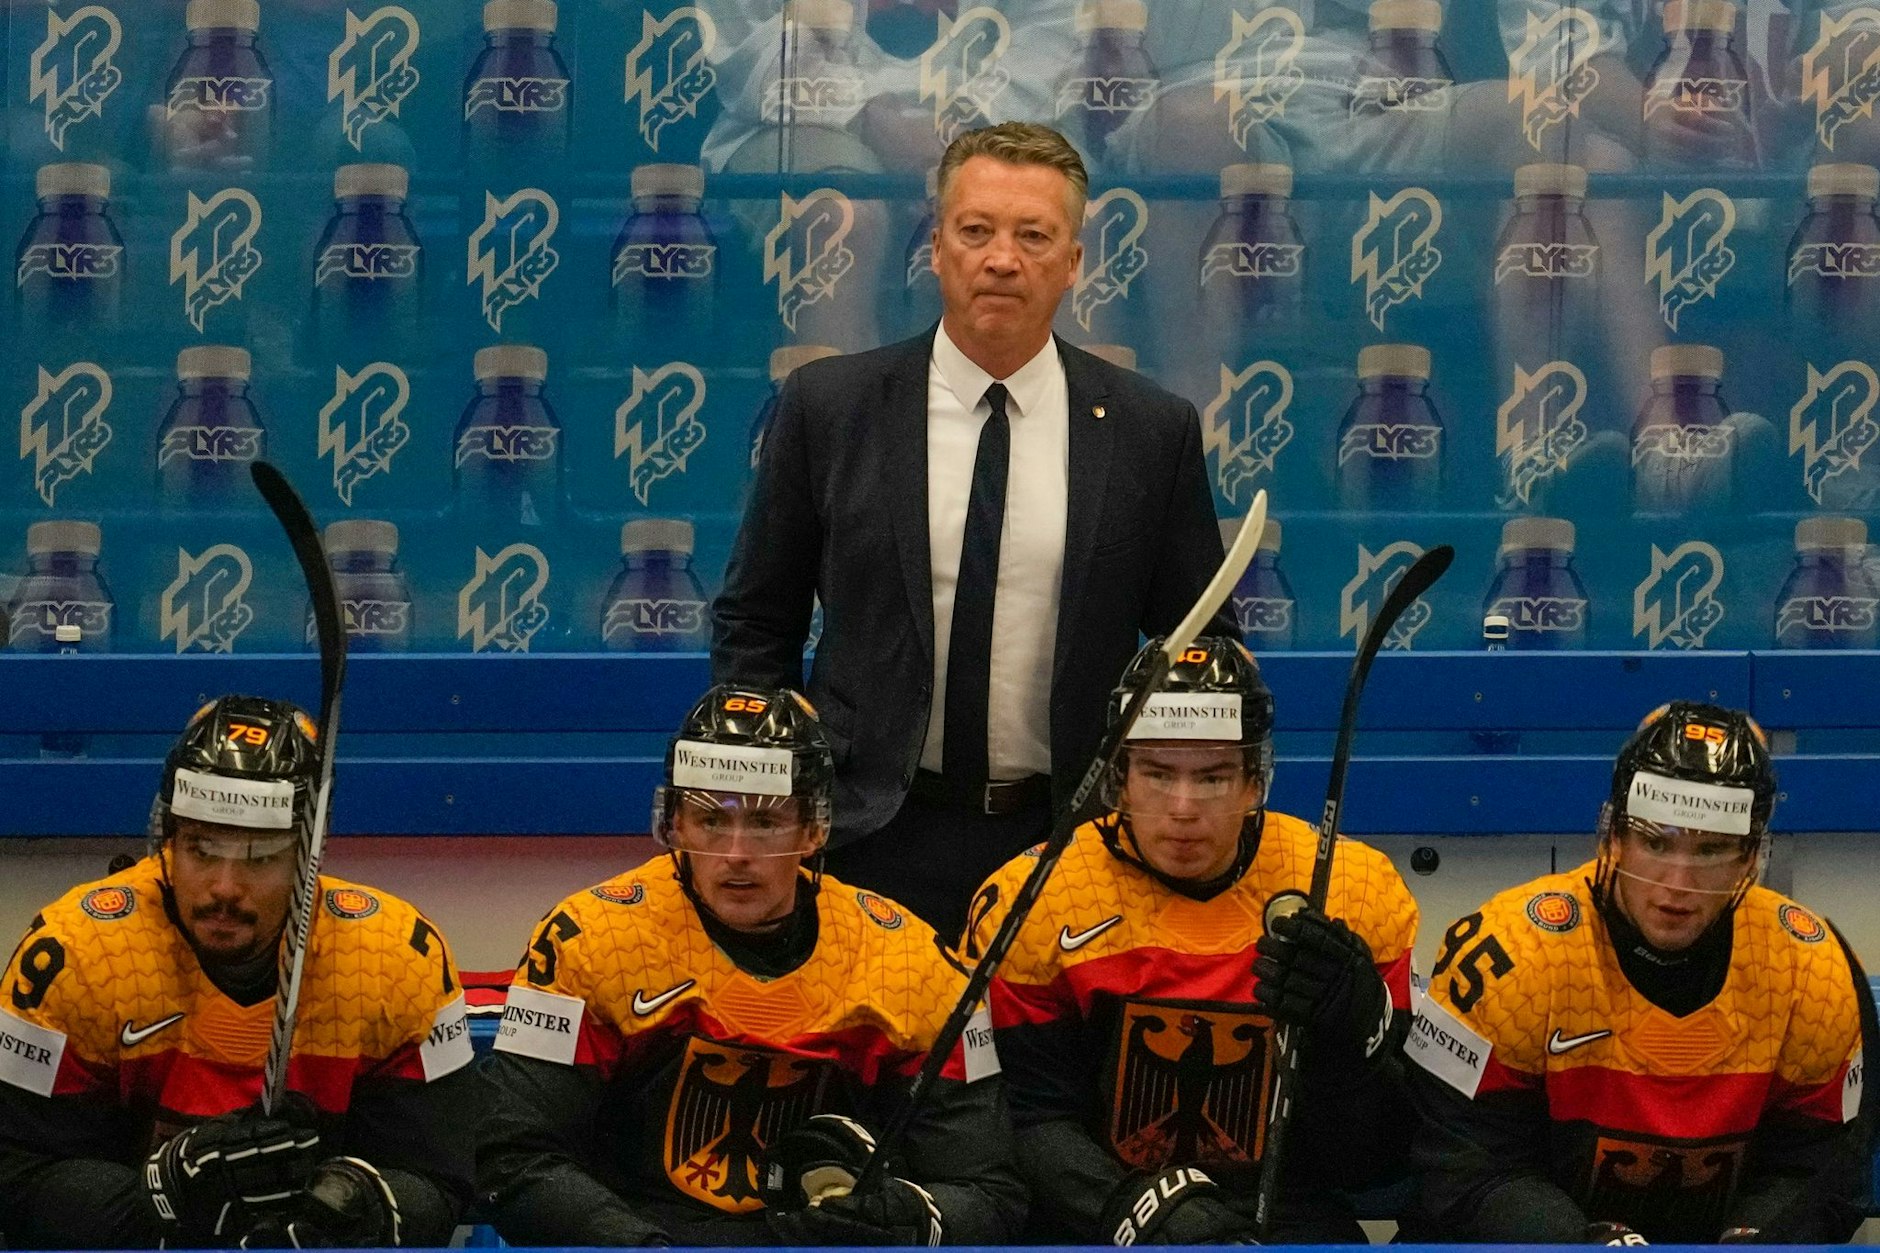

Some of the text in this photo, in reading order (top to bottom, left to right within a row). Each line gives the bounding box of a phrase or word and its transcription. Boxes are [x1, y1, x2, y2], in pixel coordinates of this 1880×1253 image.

[724, 698, 768, 714] 65
[1139, 705, 1238, 720] ESTMINSTER
[228, 724, 268, 746] 79
[1163, 720, 1197, 730] GROUP
[1685, 723, 1727, 745] 95
[678, 749, 788, 776] WESTMINSTER
[711, 772, 744, 783] GROUP
[177, 778, 290, 809] WESTMINSTER
[1635, 782, 1749, 814] WESTMINSTER
[212, 803, 245, 815] GROUP
[1673, 808, 1706, 821] GROUP
[1318, 802, 1335, 856] CCM
[517, 905, 582, 987] 5
[1432, 911, 1516, 1014] 95
